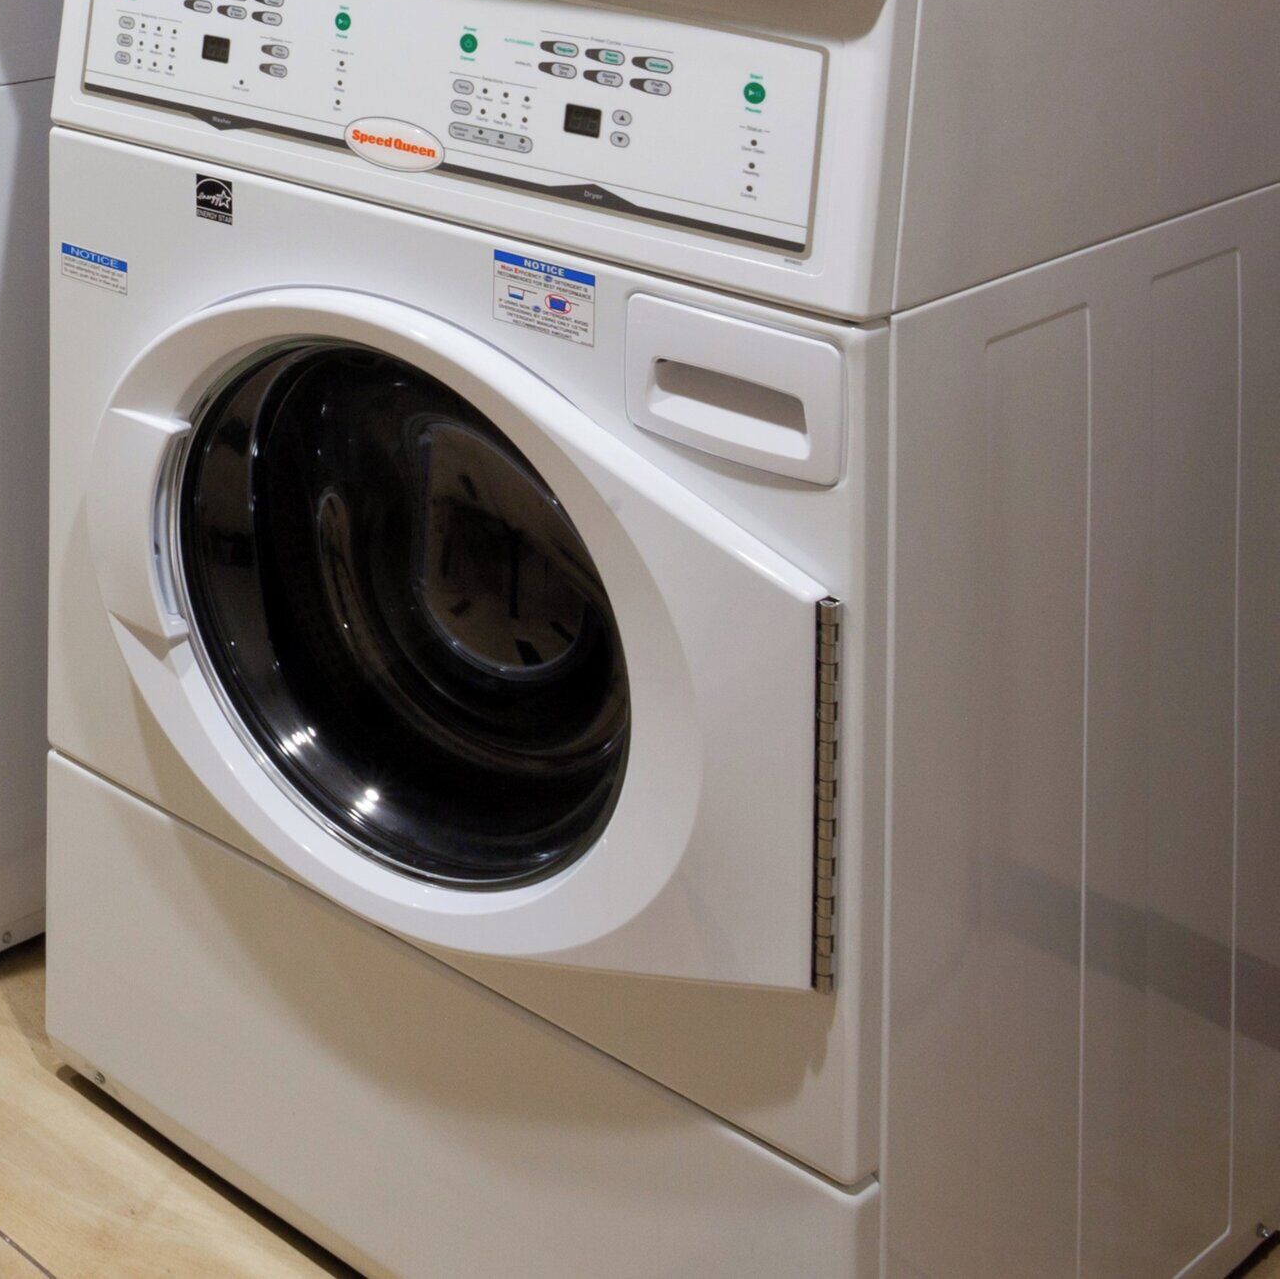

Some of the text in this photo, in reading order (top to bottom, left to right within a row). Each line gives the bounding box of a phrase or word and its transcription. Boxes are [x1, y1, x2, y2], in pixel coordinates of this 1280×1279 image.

[352, 129, 436, 158] Speed Queen
[584, 190, 603, 200] Dryer
[70, 246, 119, 269] NOTICE
[524, 259, 565, 277] NOTICE
